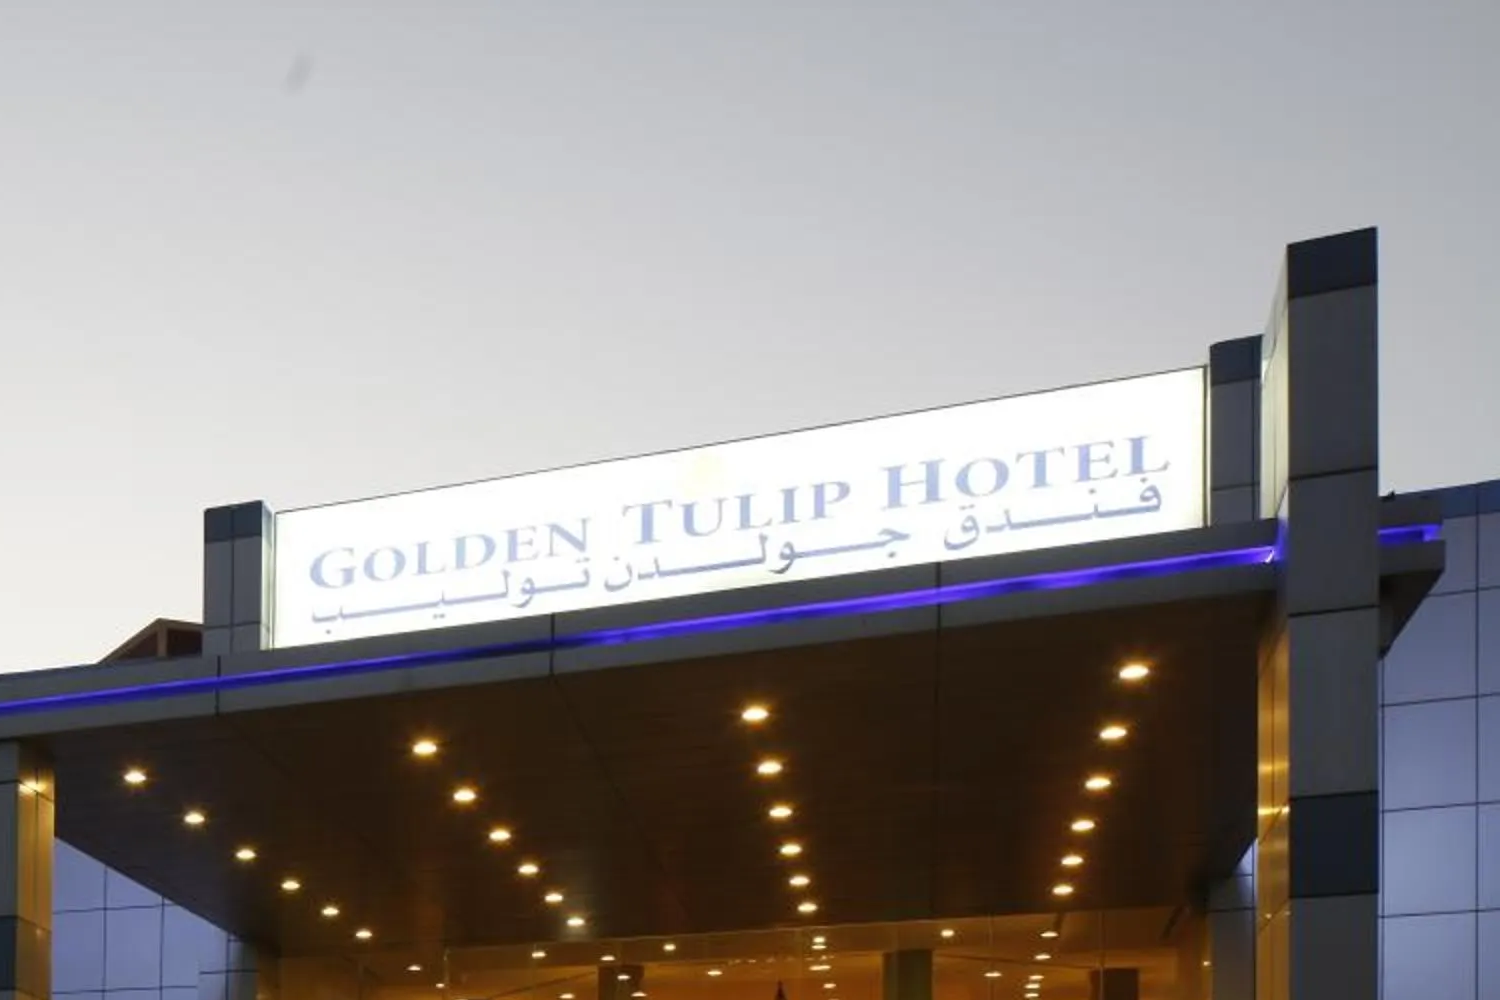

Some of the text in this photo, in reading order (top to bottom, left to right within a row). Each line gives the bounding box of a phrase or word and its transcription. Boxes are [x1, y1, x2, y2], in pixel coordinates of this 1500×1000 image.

[308, 434, 1171, 590] GOLDEN TULIP HOTEL
[943, 476, 1163, 552] فندق
[311, 556, 591, 635] توليب
